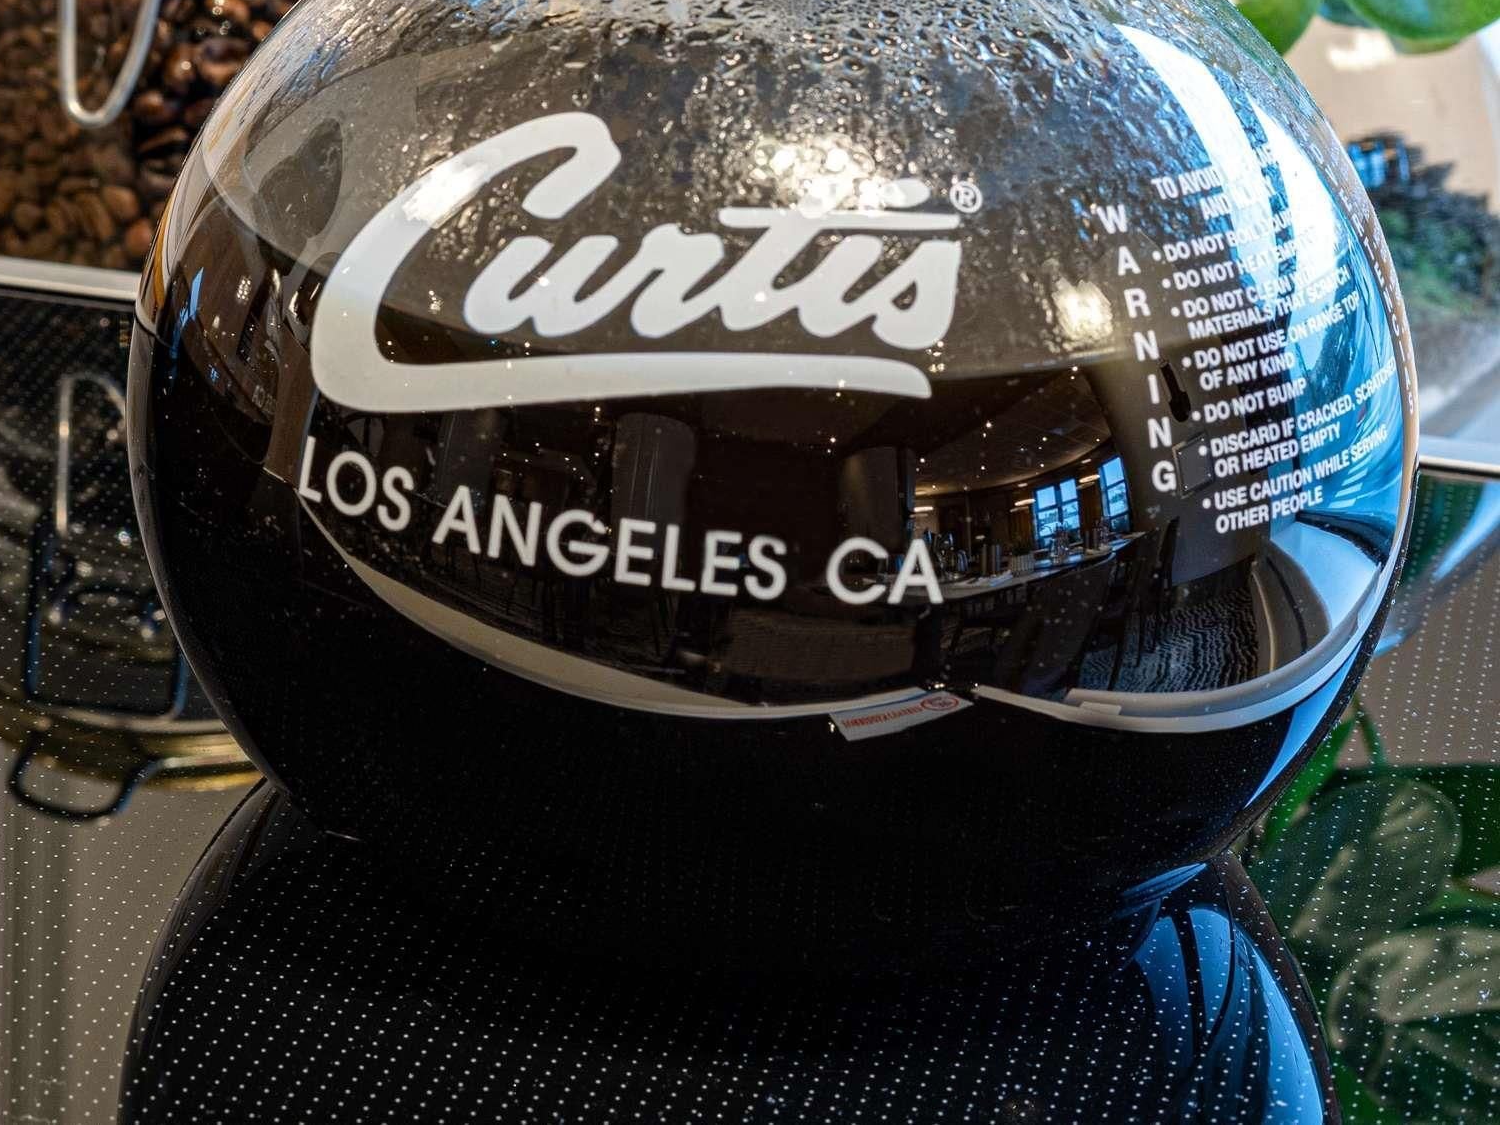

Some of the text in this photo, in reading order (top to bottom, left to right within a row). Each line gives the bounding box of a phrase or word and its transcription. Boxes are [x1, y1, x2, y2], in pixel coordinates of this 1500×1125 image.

[1150, 175, 1180, 200] TO
[1200, 193, 1233, 219] AND
[1162, 241, 1191, 263] DO
[1191, 233, 1227, 257] NOT
[1172, 270, 1201, 291] DO
[1201, 261, 1237, 285] NOT
[1181, 297, 1210, 319] DO
[1210, 288, 1246, 312] NOT
[1187, 304, 1275, 340] MATERIALS
[1194, 291, 1361, 370] DO NOT USE ON RANGE TOP
[1200, 351, 1296, 391] OF ANY KIND
[1203, 377, 1308, 424] DO NOT BUMP
[1210, 421, 1282, 457] DISCARD
[1281, 417, 1296, 438] IF
[1297, 392, 1356, 431] CRACKED,
[1214, 420, 1343, 479] OR HEATED EMPTY
[1214, 485, 1249, 511] USE
[1249, 467, 1314, 500] CAUTION
[1312, 451, 1352, 477] WHILE
[298, 433, 945, 606] LOS ANGELES CA
[1215, 485, 1324, 535] OTHER PEOPLE
